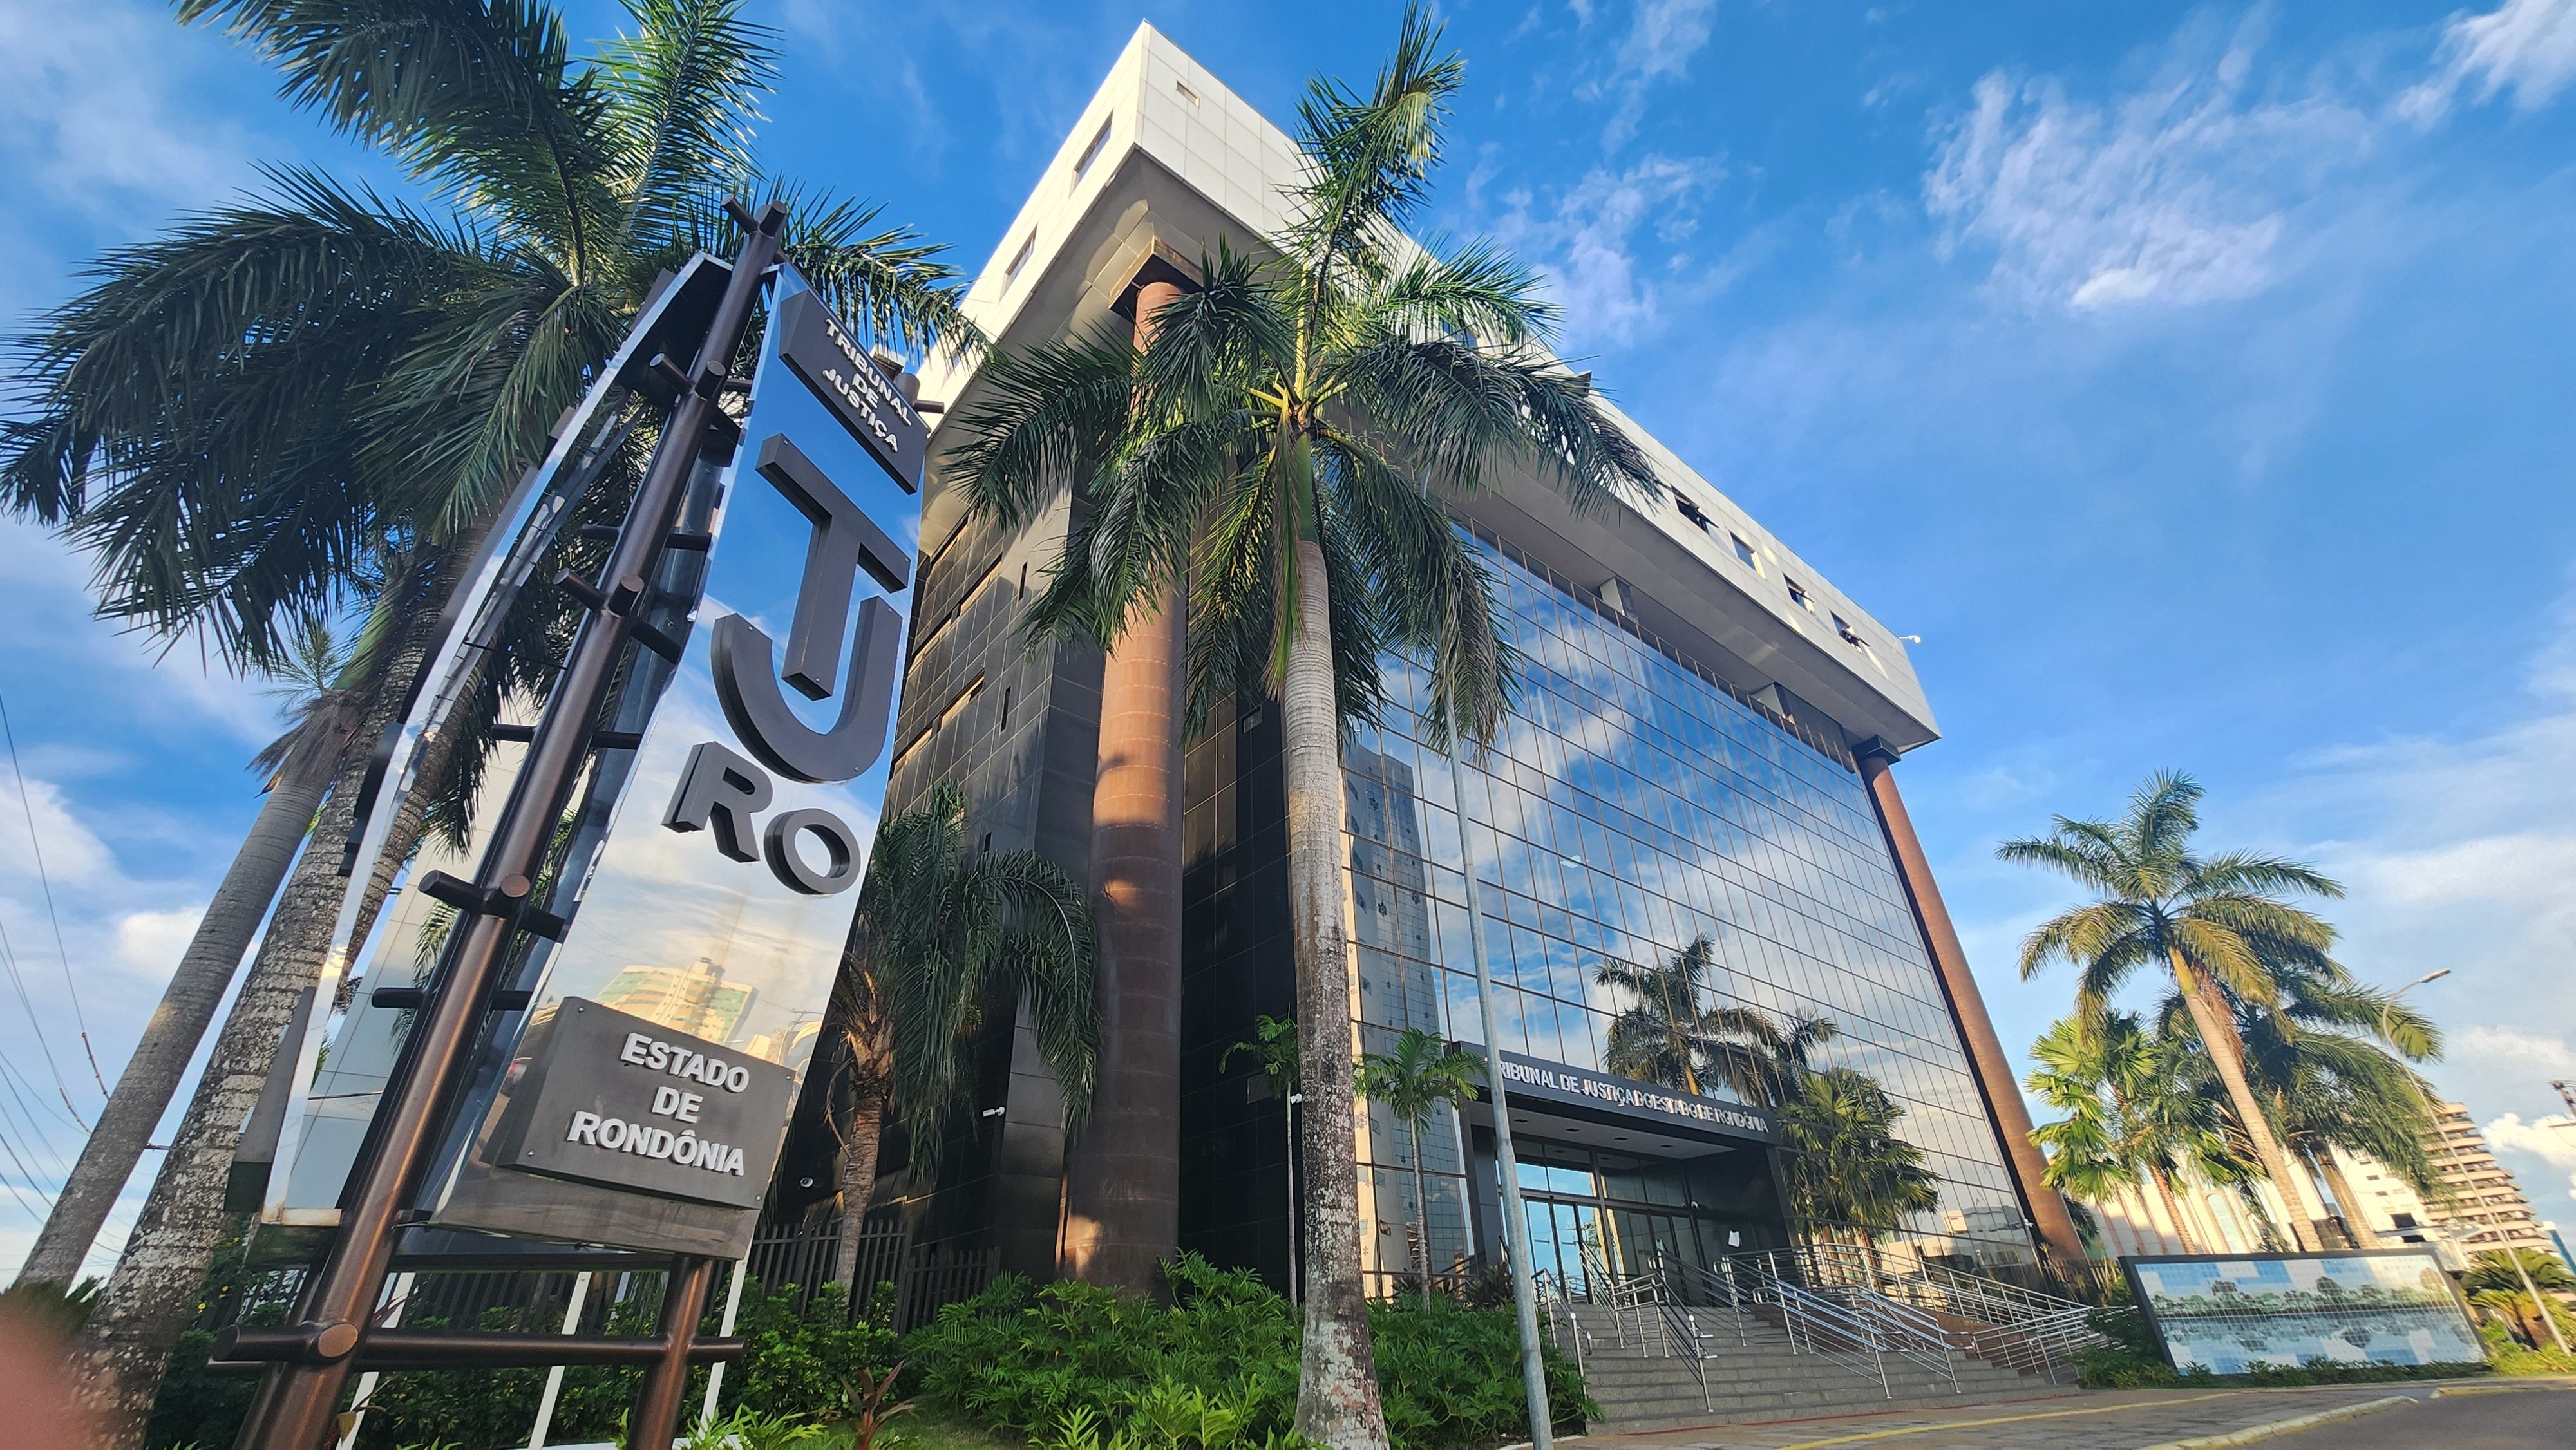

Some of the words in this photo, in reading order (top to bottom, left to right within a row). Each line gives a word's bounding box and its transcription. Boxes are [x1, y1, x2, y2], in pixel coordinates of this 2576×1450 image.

[826, 318, 912, 426] TRIBUNAL
[852, 373, 878, 408] DE
[822, 368, 898, 452] JUSTIÇA
[661, 740, 861, 895] RO
[620, 1032, 750, 1093] ESTADO
[1484, 1057, 1559, 1089] RIBUNAL
[1559, 1073, 1580, 1093] DE
[1581, 1078, 1634, 1107] JUSTIÇA
[1714, 1110, 1769, 1133] RONDÔNIA
[651, 1086, 703, 1124] DE
[567, 1111, 744, 1176] RONDÔNIA
